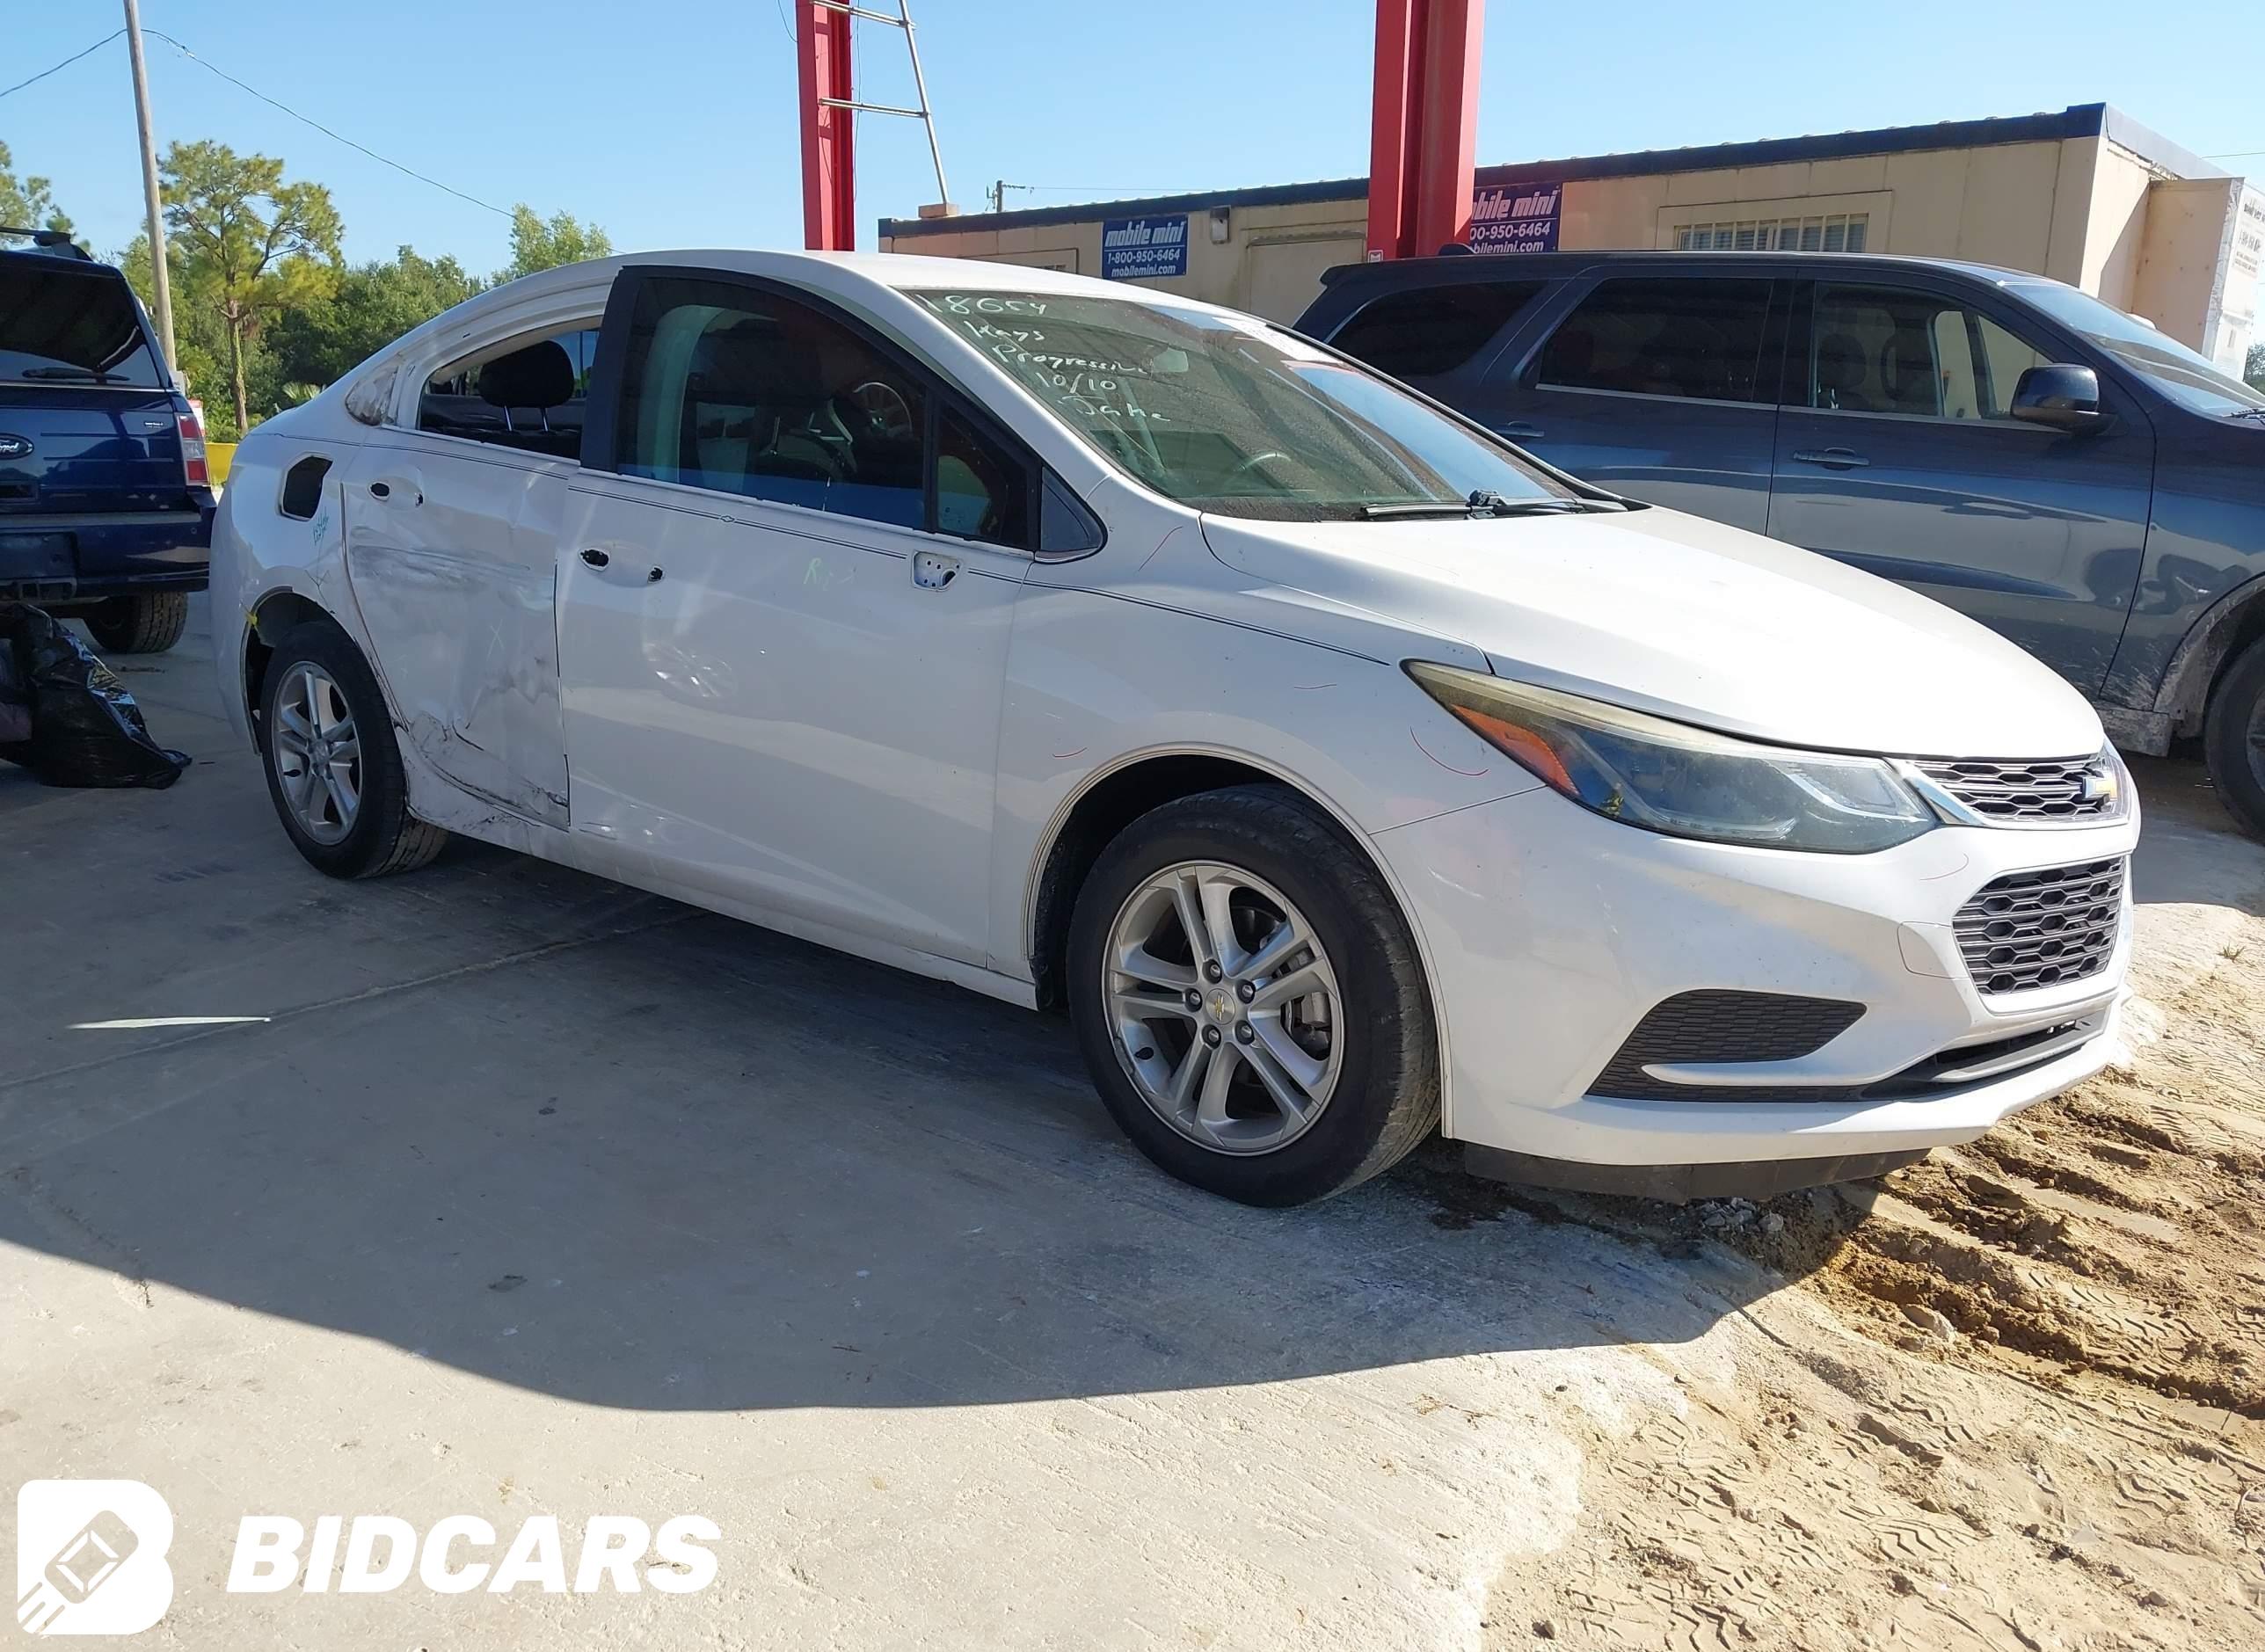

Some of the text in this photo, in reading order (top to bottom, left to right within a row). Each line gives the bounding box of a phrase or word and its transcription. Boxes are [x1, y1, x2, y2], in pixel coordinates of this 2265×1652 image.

[1471, 189, 1558, 220] bile mini
[1104, 220, 1185, 247] mobile mini
[1469, 222, 1551, 241] 00-950-6464
[1473, 240, 1544, 254] bilemini.com
[1107, 249, 1181, 265] 1-800-950-6464
[1111, 265, 1176, 277] mobilemini.com
[1036, 372, 1118, 394] 10/10
[0, 439, 19, 453] ord
